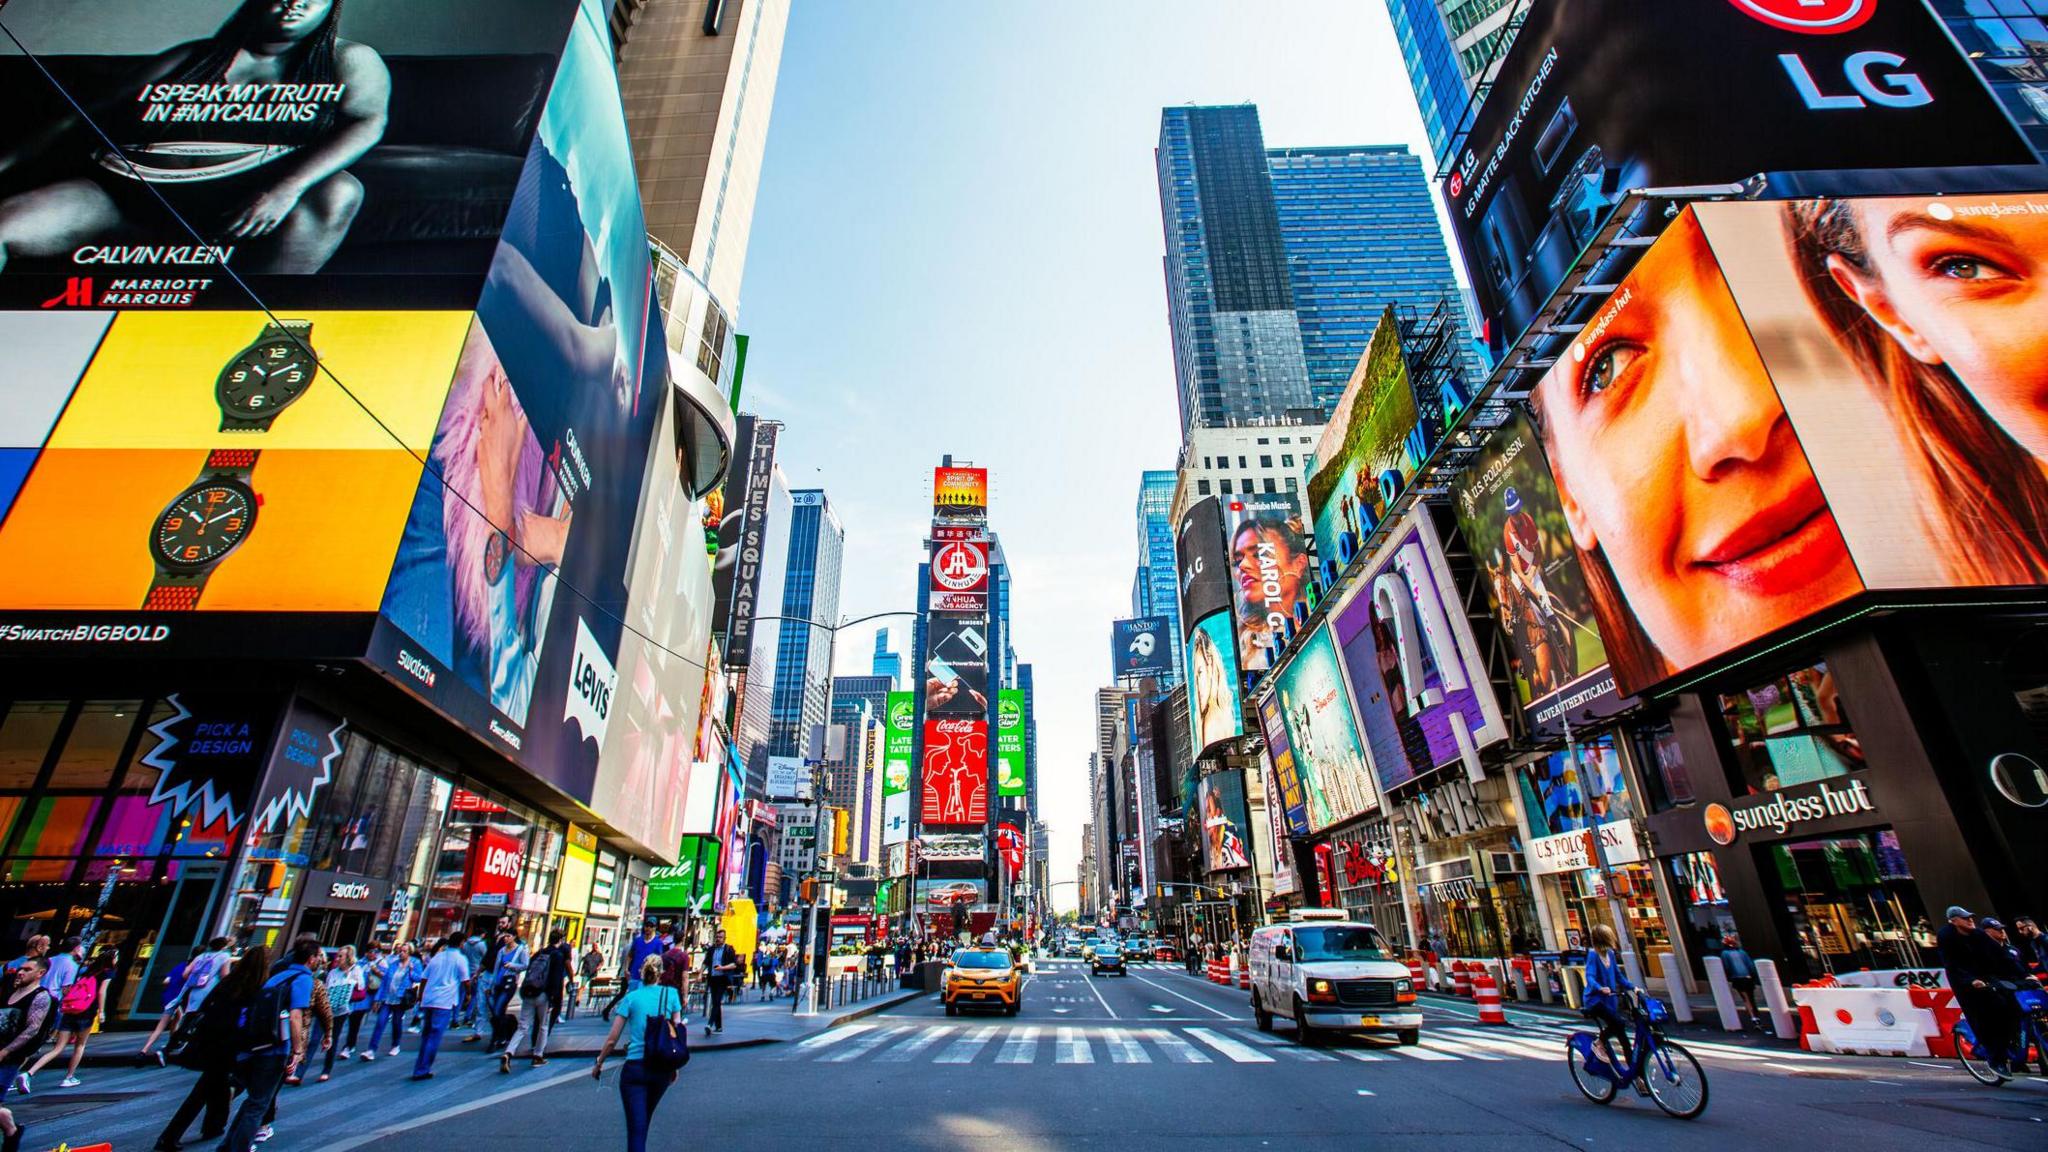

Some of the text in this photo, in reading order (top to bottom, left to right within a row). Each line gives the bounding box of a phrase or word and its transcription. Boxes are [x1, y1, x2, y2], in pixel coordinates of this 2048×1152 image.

[1777, 50, 1935, 109] LG
[138, 84, 345, 101] I SPEAK MY TRUTH
[142, 103, 320, 121] IN #MYCALVINS
[1465, 197, 1476, 218] LG
[1473, 156, 1499, 202] MATTE
[1496, 110, 1523, 160] BLACK
[1520, 46, 1558, 116] KITCHEN
[1460, 149, 1475, 179] LG
[1955, 201, 2048, 219] sunglass hu
[73, 246, 234, 265] CALVIN KLEIN
[111, 279, 212, 290] MARRIOTT
[103, 293, 192, 305] MARQUIS
[1585, 288, 1632, 347] sunglass hut
[269, 348, 287, 358] 12
[232, 371, 302, 382] 9 3
[249, 395, 264, 406] 6
[1483, 460, 1502, 487] POLO
[1501, 437, 1525, 467] ASSN.
[750, 444, 773, 521] TIMES
[207, 491, 227, 502] 12
[1244, 500, 1292, 510] YouTube Music
[167, 518, 241, 530] 9 3
[183, 546, 200, 558] 6
[734, 530, 760, 636] SQUARE
[943, 577, 976, 588] XINHUA
[1257, 542, 1283, 608] KAROL
[1266, 611, 1286, 631] G
[397, 649, 431, 684] swatch
[574, 652, 610, 720] Levi's
[196, 723, 249, 737] PICK A
[189, 740, 253, 753] DESIGN
[1733, 779, 1875, 834] sunglass hut
[1535, 840, 1555, 859] U.S.
[1555, 834, 1585, 855] POLO
[483, 845, 520, 879] Levi's
[1557, 858, 1581, 868] SINCE
[330, 882, 365, 899] swatch
